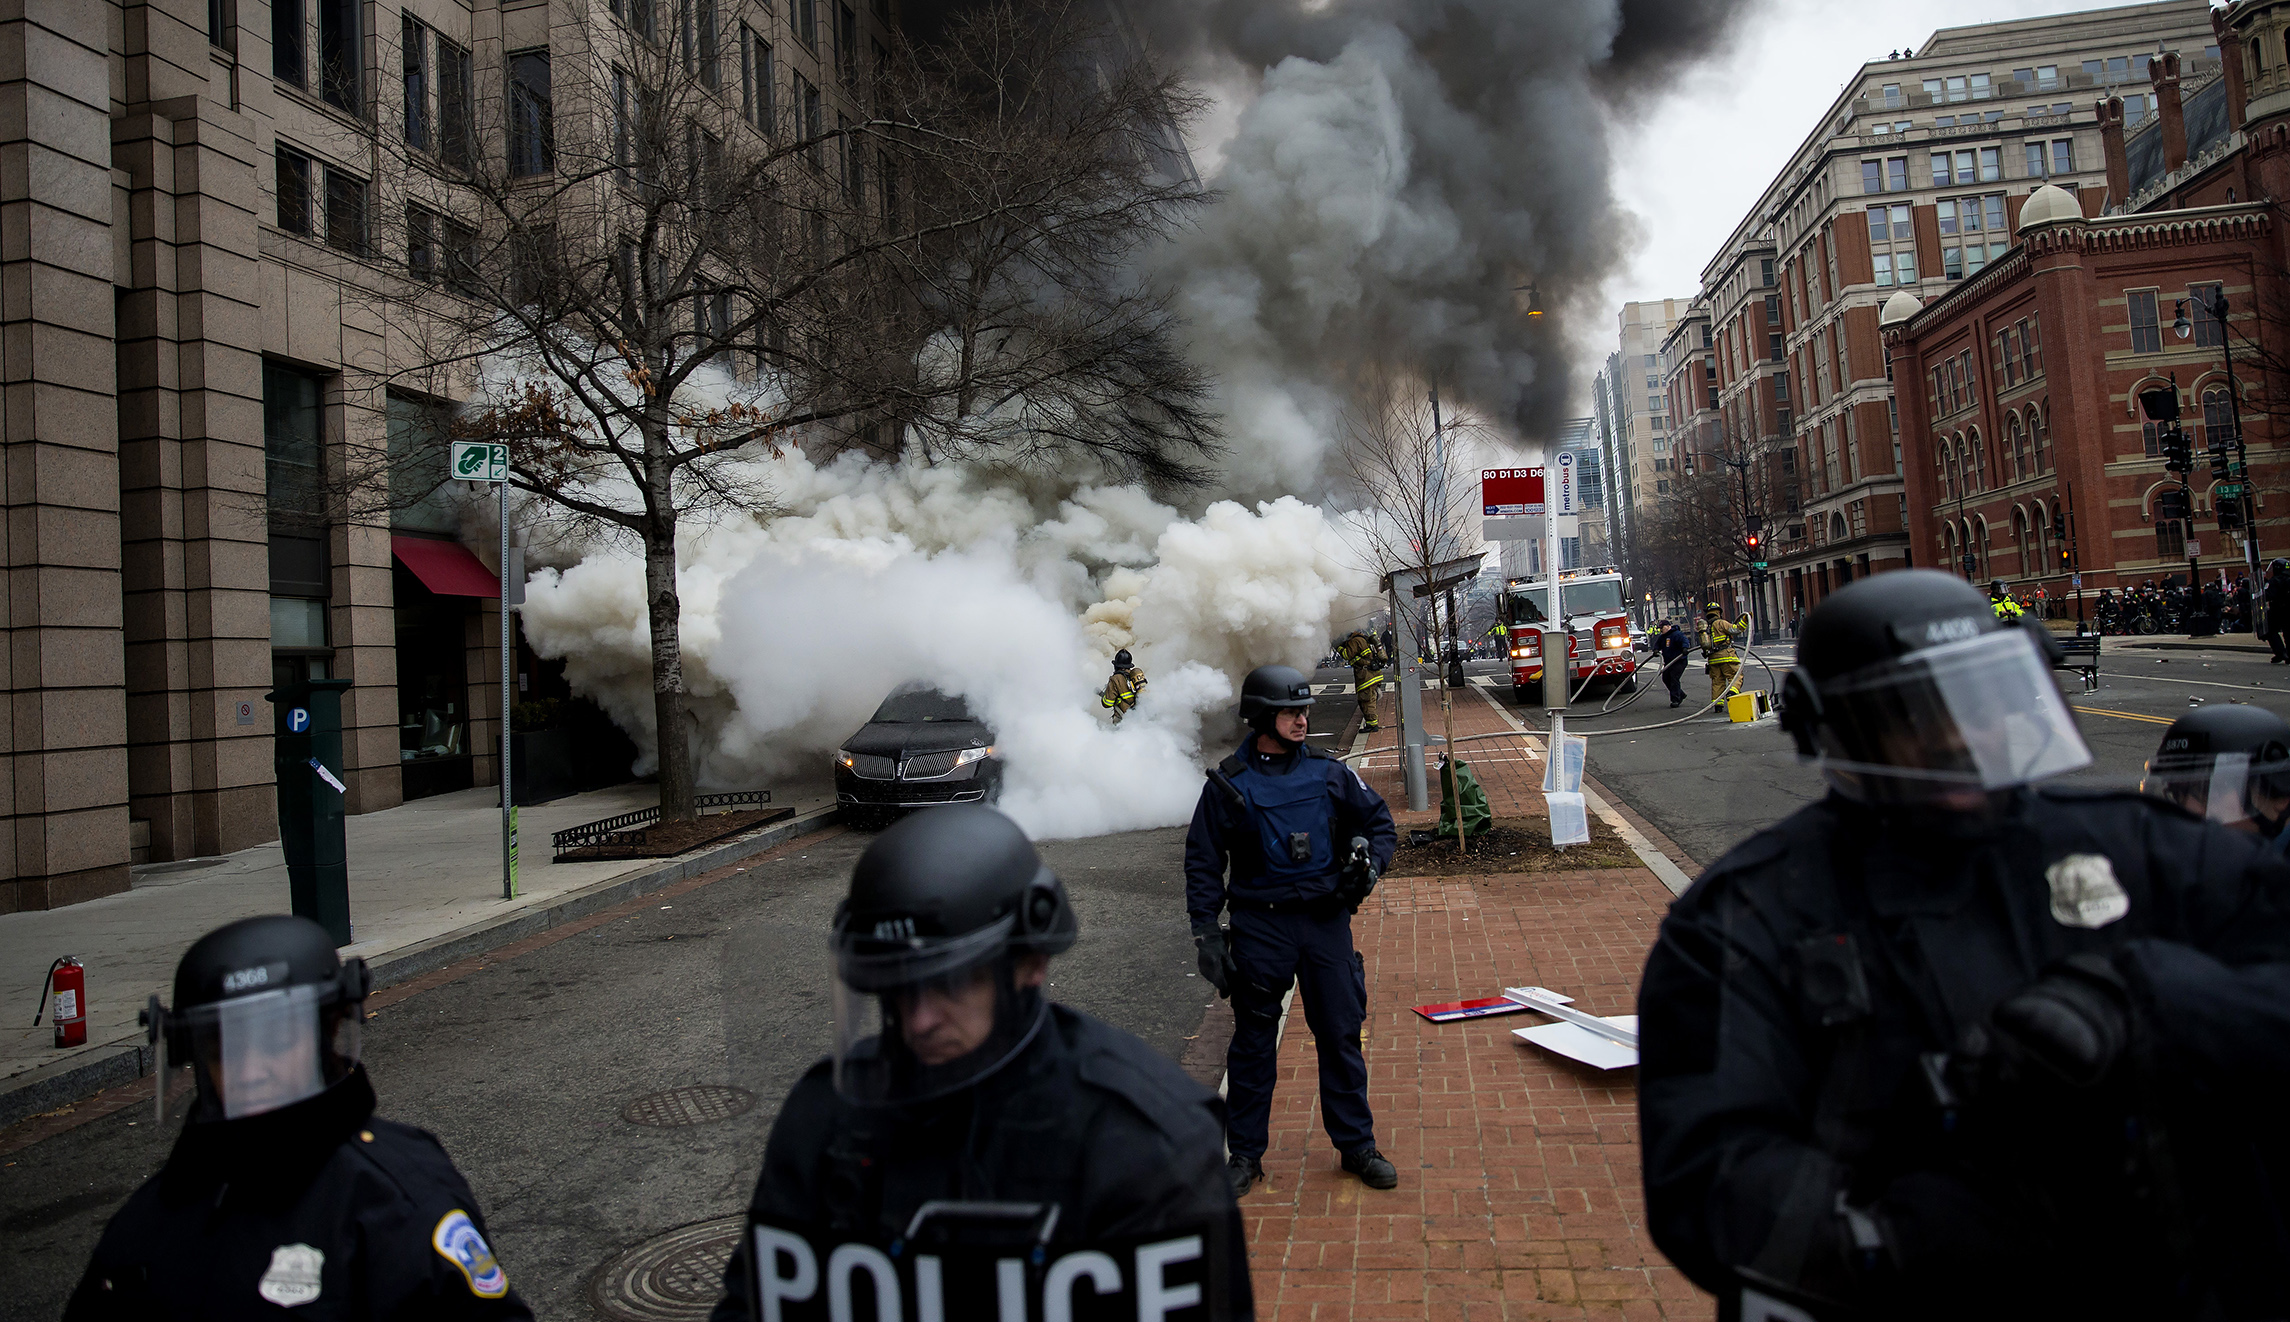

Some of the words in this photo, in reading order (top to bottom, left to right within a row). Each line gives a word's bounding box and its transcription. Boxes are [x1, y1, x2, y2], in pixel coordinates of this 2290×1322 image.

[493, 446, 504, 460] 2
[1483, 470, 1497, 480] 80
[1499, 470, 1511, 479] D1
[1513, 469, 1527, 478] D3
[1530, 468, 1544, 478] D6
[1562, 467, 1570, 511] metrobus
[293, 708, 308, 732] P
